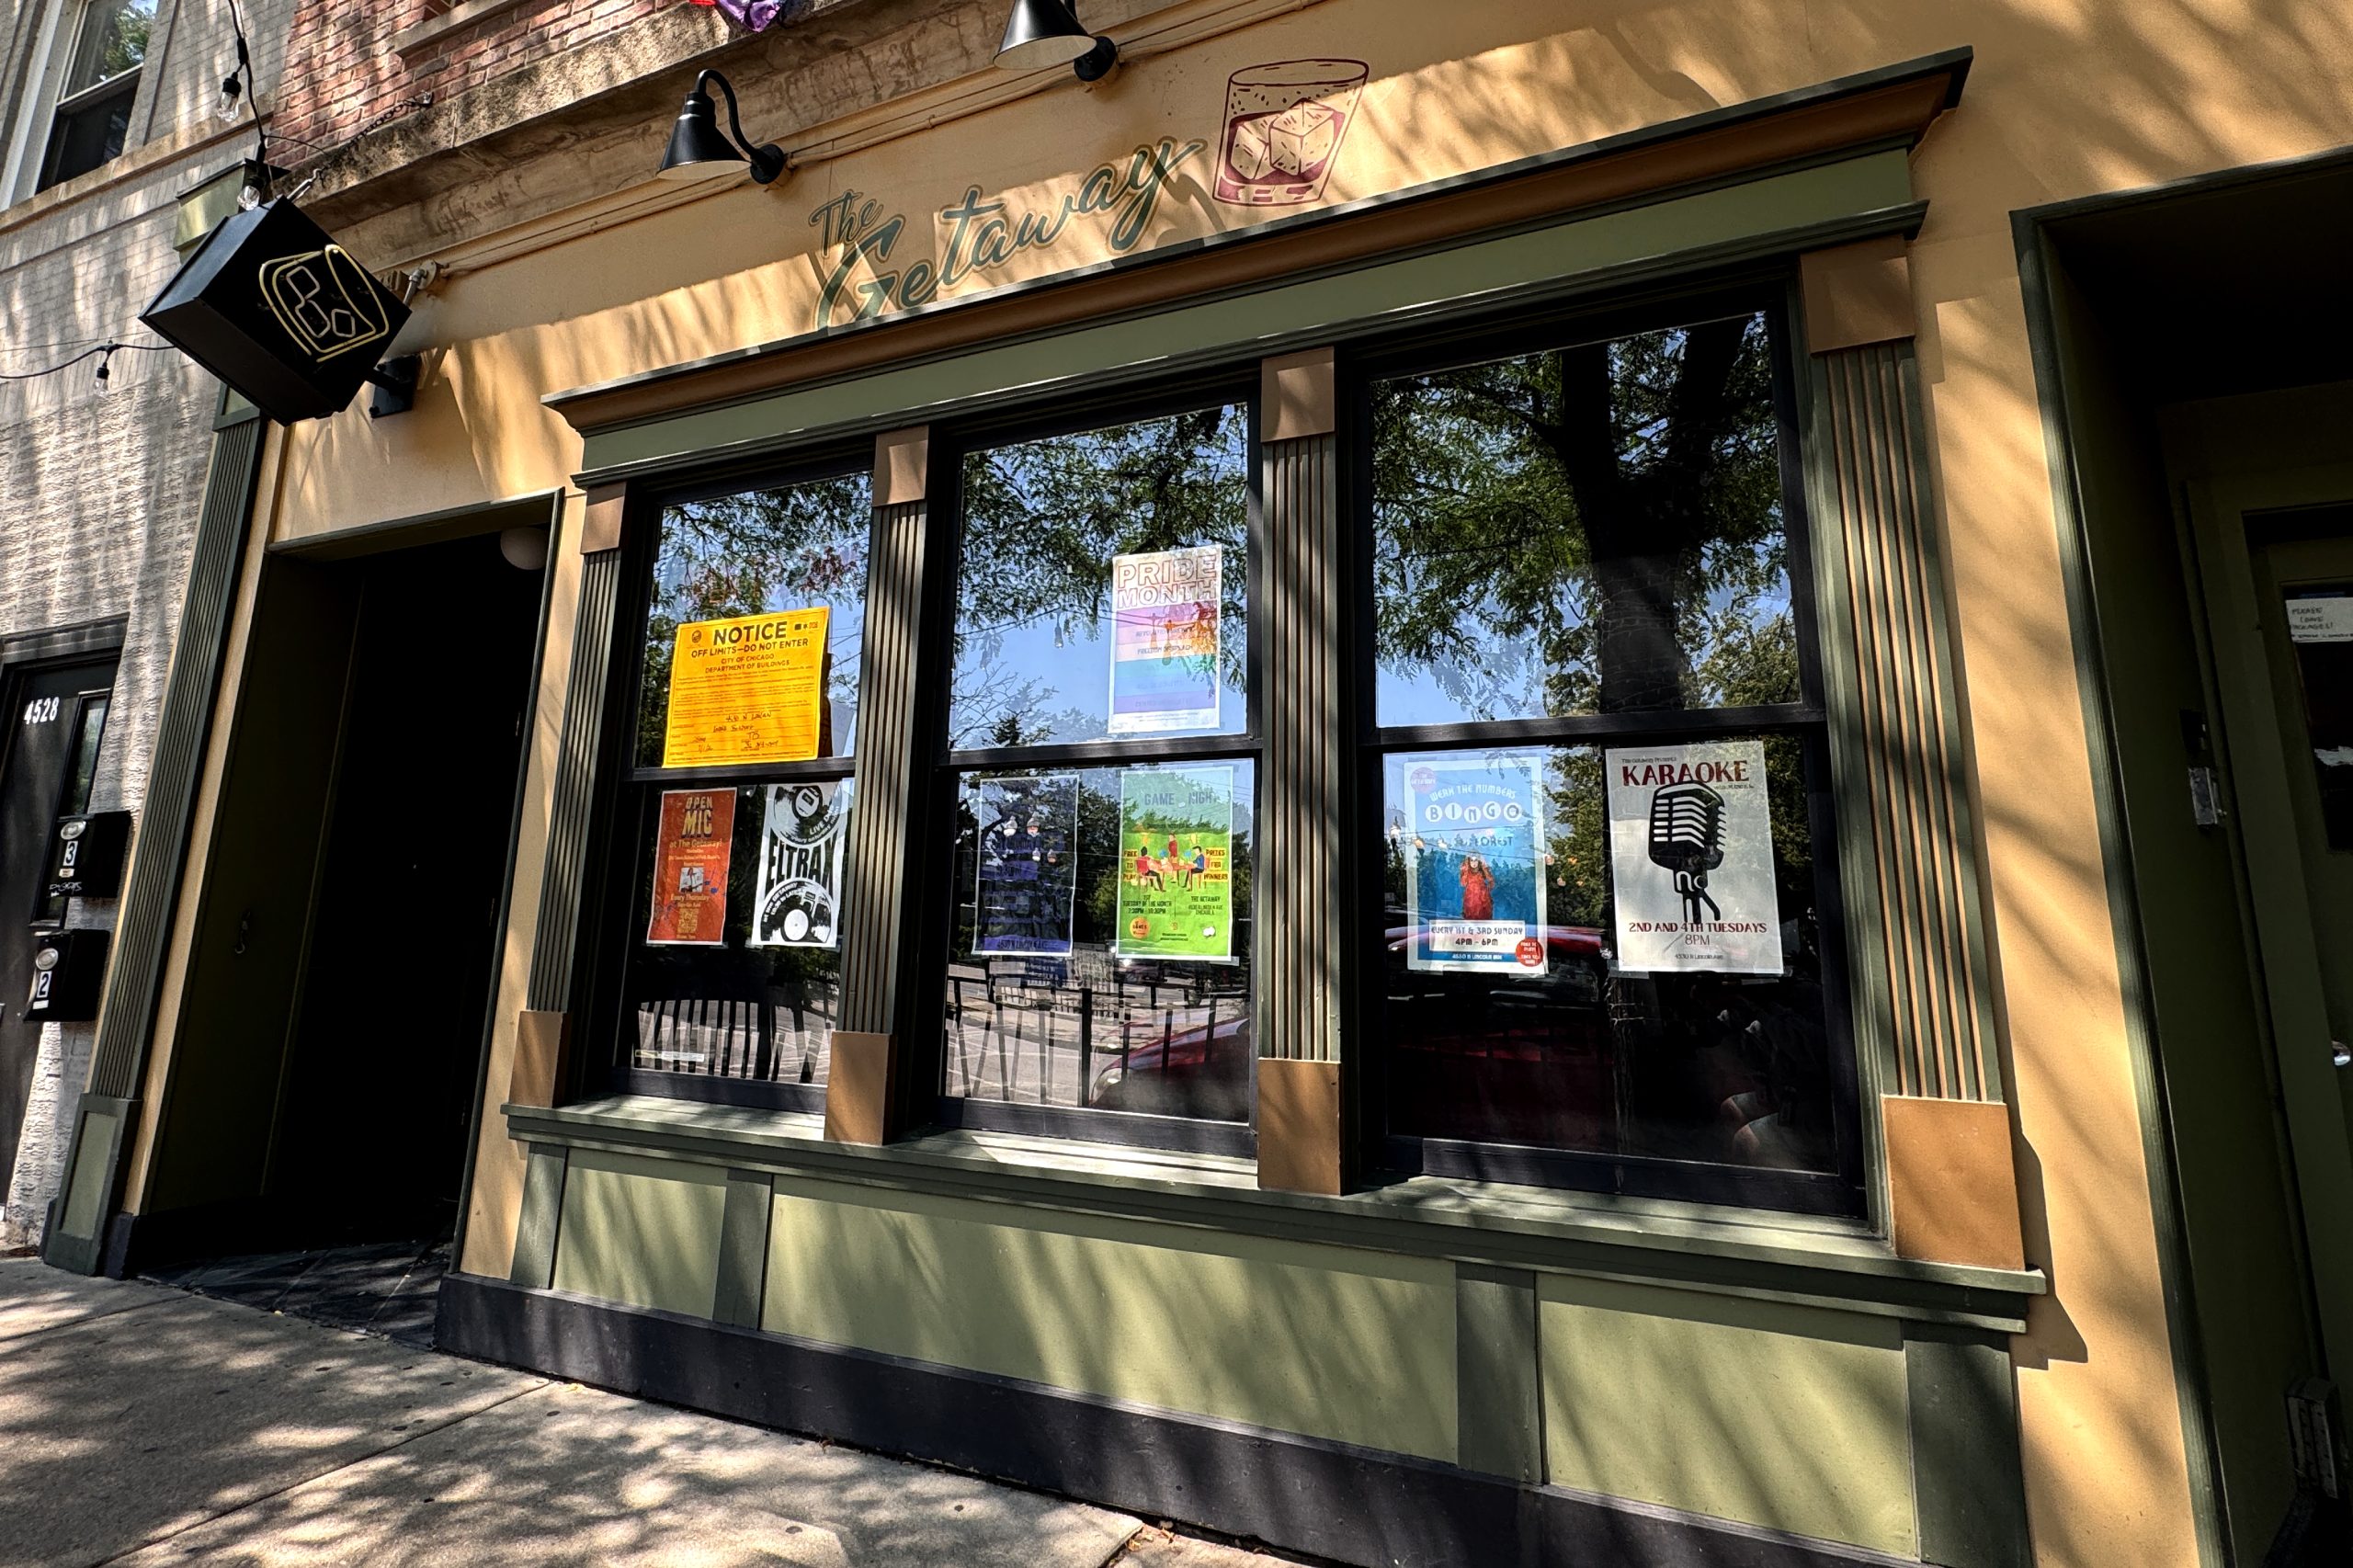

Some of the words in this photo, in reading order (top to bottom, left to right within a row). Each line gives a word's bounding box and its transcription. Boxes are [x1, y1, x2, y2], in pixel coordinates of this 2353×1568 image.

[808, 187, 889, 257] The
[816, 135, 1208, 328] Getaway
[1118, 553, 1218, 589] PRIDE
[1117, 580, 1217, 608] MONTH
[713, 621, 788, 645] NOTICE
[691, 649, 709, 658] OFF
[759, 642, 778, 651] NOT
[779, 638, 809, 649] ENTER
[745, 653, 775, 662] CHICAGO
[705, 664, 745, 674] DEPARTMENT
[757, 660, 790, 669] BUILDINGS
[24, 697, 60, 724] 4528
[1622, 760, 1750, 787] KARAOKE
[1144, 792, 1175, 806] GAME
[1457, 784, 1472, 794] THE
[1475, 784, 1517, 800] NUMBERS
[686, 796, 713, 810] OPEN
[1429, 802, 1520, 822] BINGO
[681, 809, 713, 835] MIC
[810, 821, 825, 835] LIVE
[66, 843, 74, 864] 3
[669, 840, 677, 848] at
[678, 839, 691, 847] The
[1476, 926, 1493, 935] 3RD
[1494, 926, 1523, 935] SUNDAY
[1629, 923, 1652, 932] 2ND
[1654, 923, 1678, 932] AND
[1681, 923, 1704, 932] 4TH
[1706, 923, 1768, 933] TUESDAYS
[1685, 934, 1711, 946] 8PM
[40, 973, 49, 995] 2
